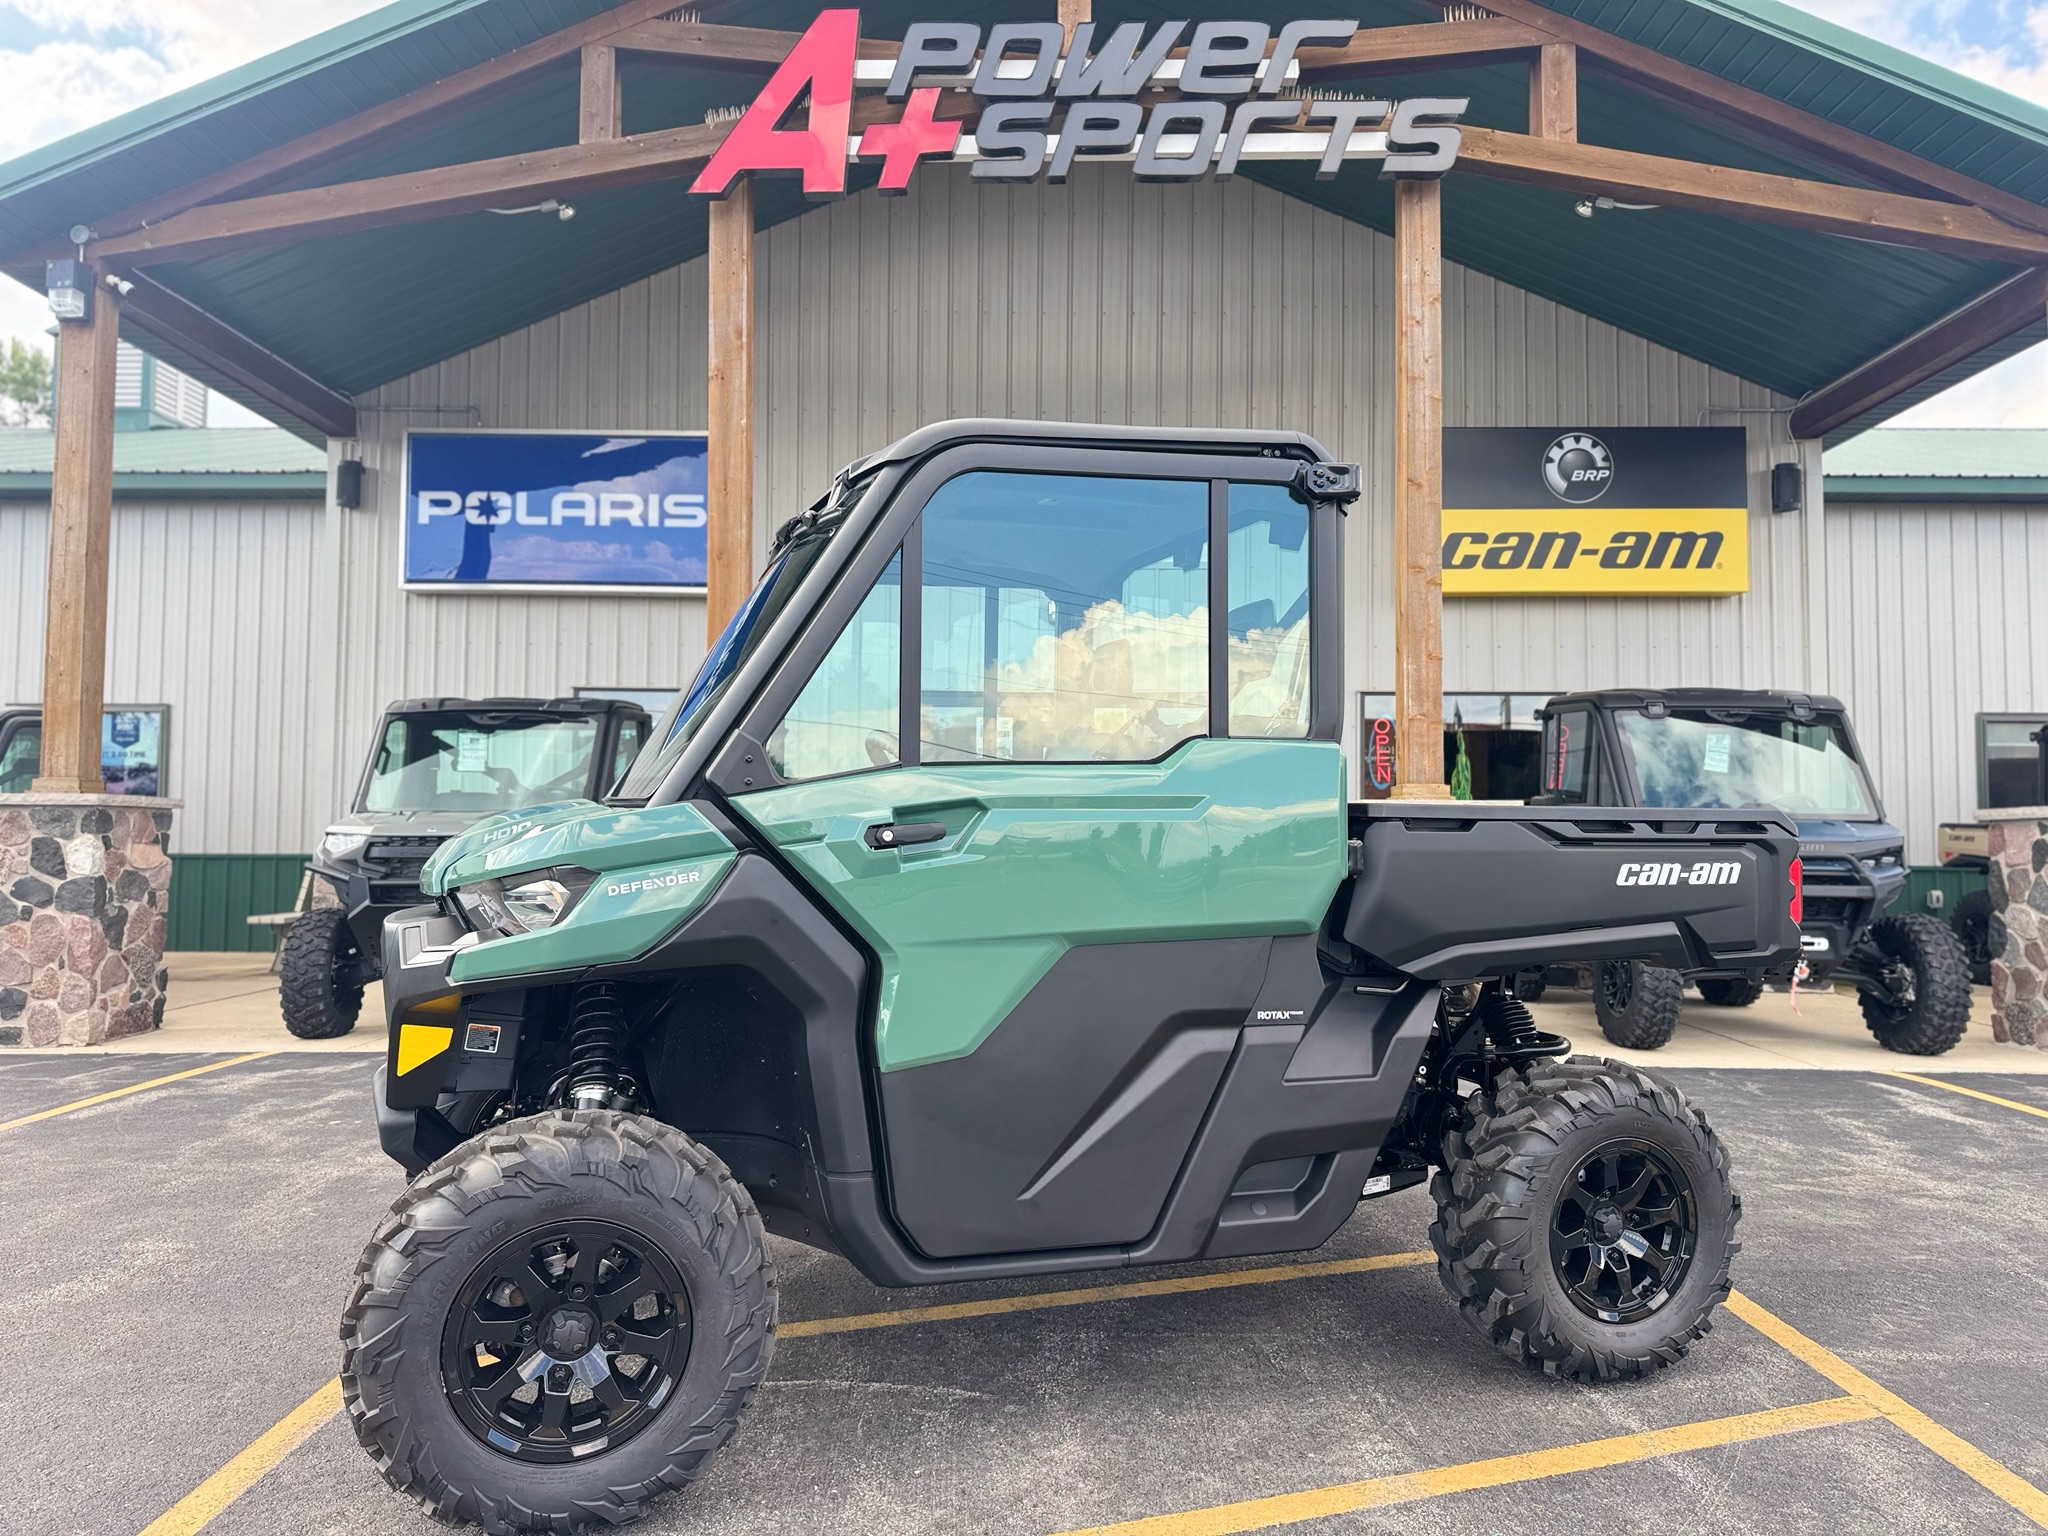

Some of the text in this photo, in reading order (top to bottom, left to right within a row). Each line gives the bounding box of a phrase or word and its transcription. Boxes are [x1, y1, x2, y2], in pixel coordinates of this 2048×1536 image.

[1570, 469, 1610, 482] BRP
[417, 490, 707, 528] POLARIS
[1441, 531, 1724, 570] can-am
[1374, 718, 1391, 783] OPEN
[607, 871, 700, 897] DEFENDER
[1616, 862, 1741, 886] can-am
[1257, 1011, 1290, 1020] ROTAX
